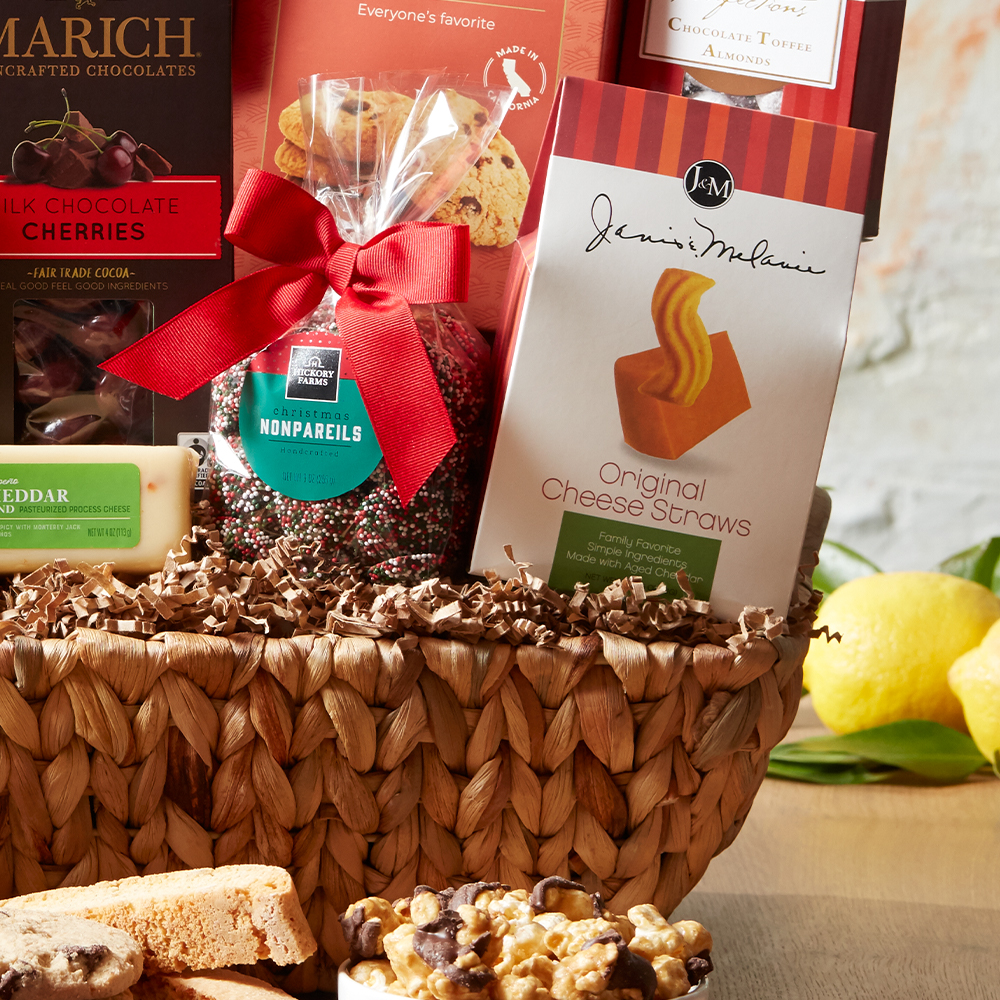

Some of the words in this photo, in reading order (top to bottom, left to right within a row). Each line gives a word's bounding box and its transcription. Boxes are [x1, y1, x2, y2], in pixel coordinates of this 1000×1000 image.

[357, 3, 437, 25] Everyone's
[440, 12, 496, 31] favorite
[668, 17, 752, 43] CHOCOLATE
[756, 30, 812, 53] TOFFEE
[702, 43, 772, 67] ALMONDS
[86, 64, 196, 78] CHOCOLATES
[45, 197, 180, 214] CHOCOLATE
[22, 222, 146, 241] CHERRIES
[19, 281, 49, 291] GOOD
[51, 281, 72, 290] FEEL
[75, 281, 105, 291] GOOD
[108, 281, 169, 291] INGREDIENTS
[298, 377, 329, 387] FARMS
[273, 406, 350, 421] christmas
[260, 418, 362, 442] NONPAREILS
[599, 462, 707, 502] Original
[19, 505, 67, 514] PASTEURIZED
[69, 505, 102, 514] PROCESS
[103, 505, 131, 513] CHEESE
[541, 477, 645, 518] Cheese
[651, 499, 752, 538] Straws
[587, 541, 622, 557] Simple
[625, 549, 688, 570] Ingredients
[599, 531, 633, 549] Family
[636, 538, 682, 556] Favorite
